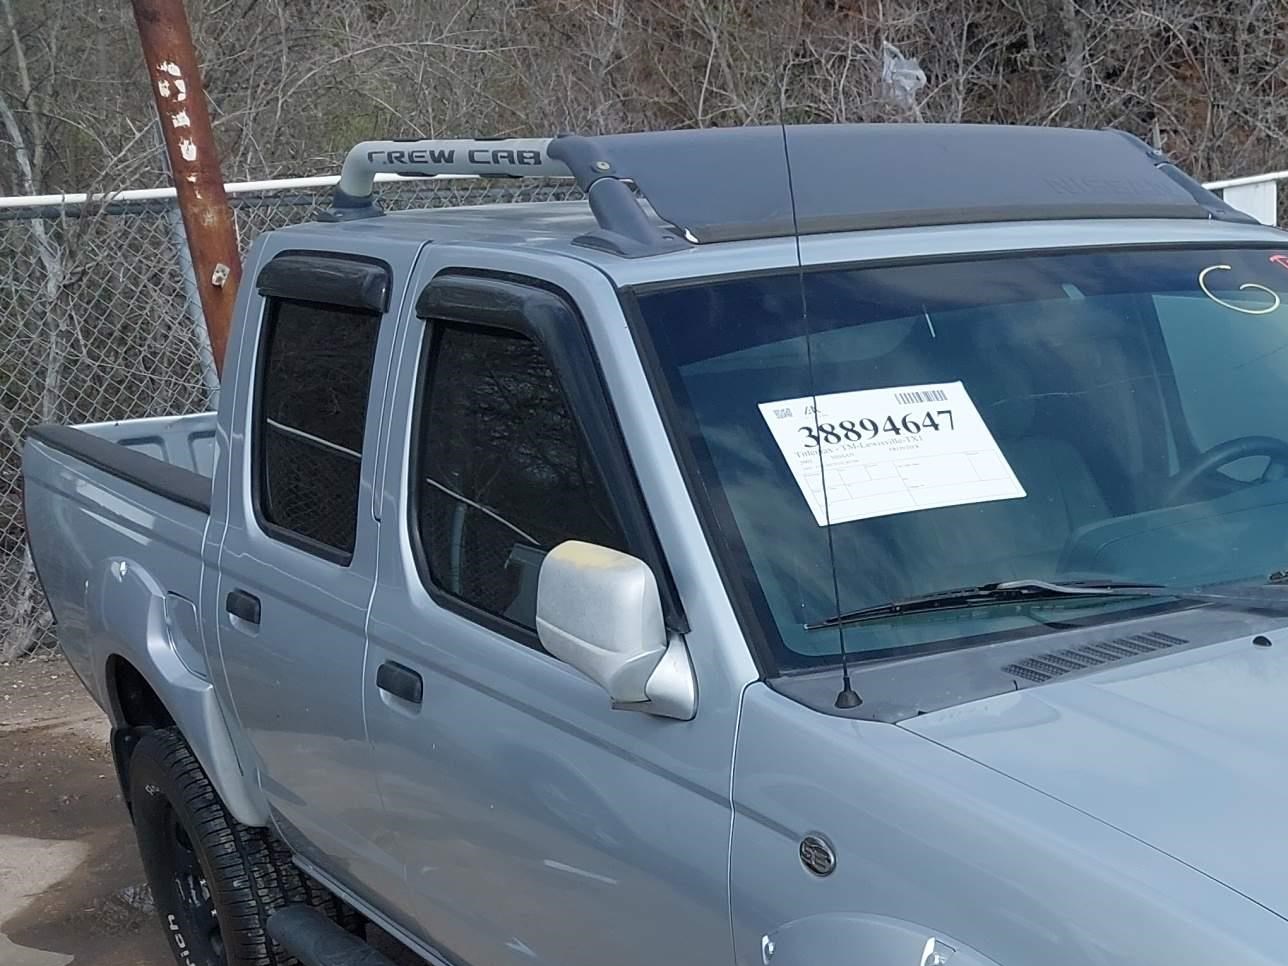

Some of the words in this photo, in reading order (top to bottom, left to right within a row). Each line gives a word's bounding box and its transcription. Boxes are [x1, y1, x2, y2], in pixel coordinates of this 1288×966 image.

[367, 149, 456, 165] CREW
[468, 149, 543, 165] CAB
[798, 410, 954, 449] 38894647
